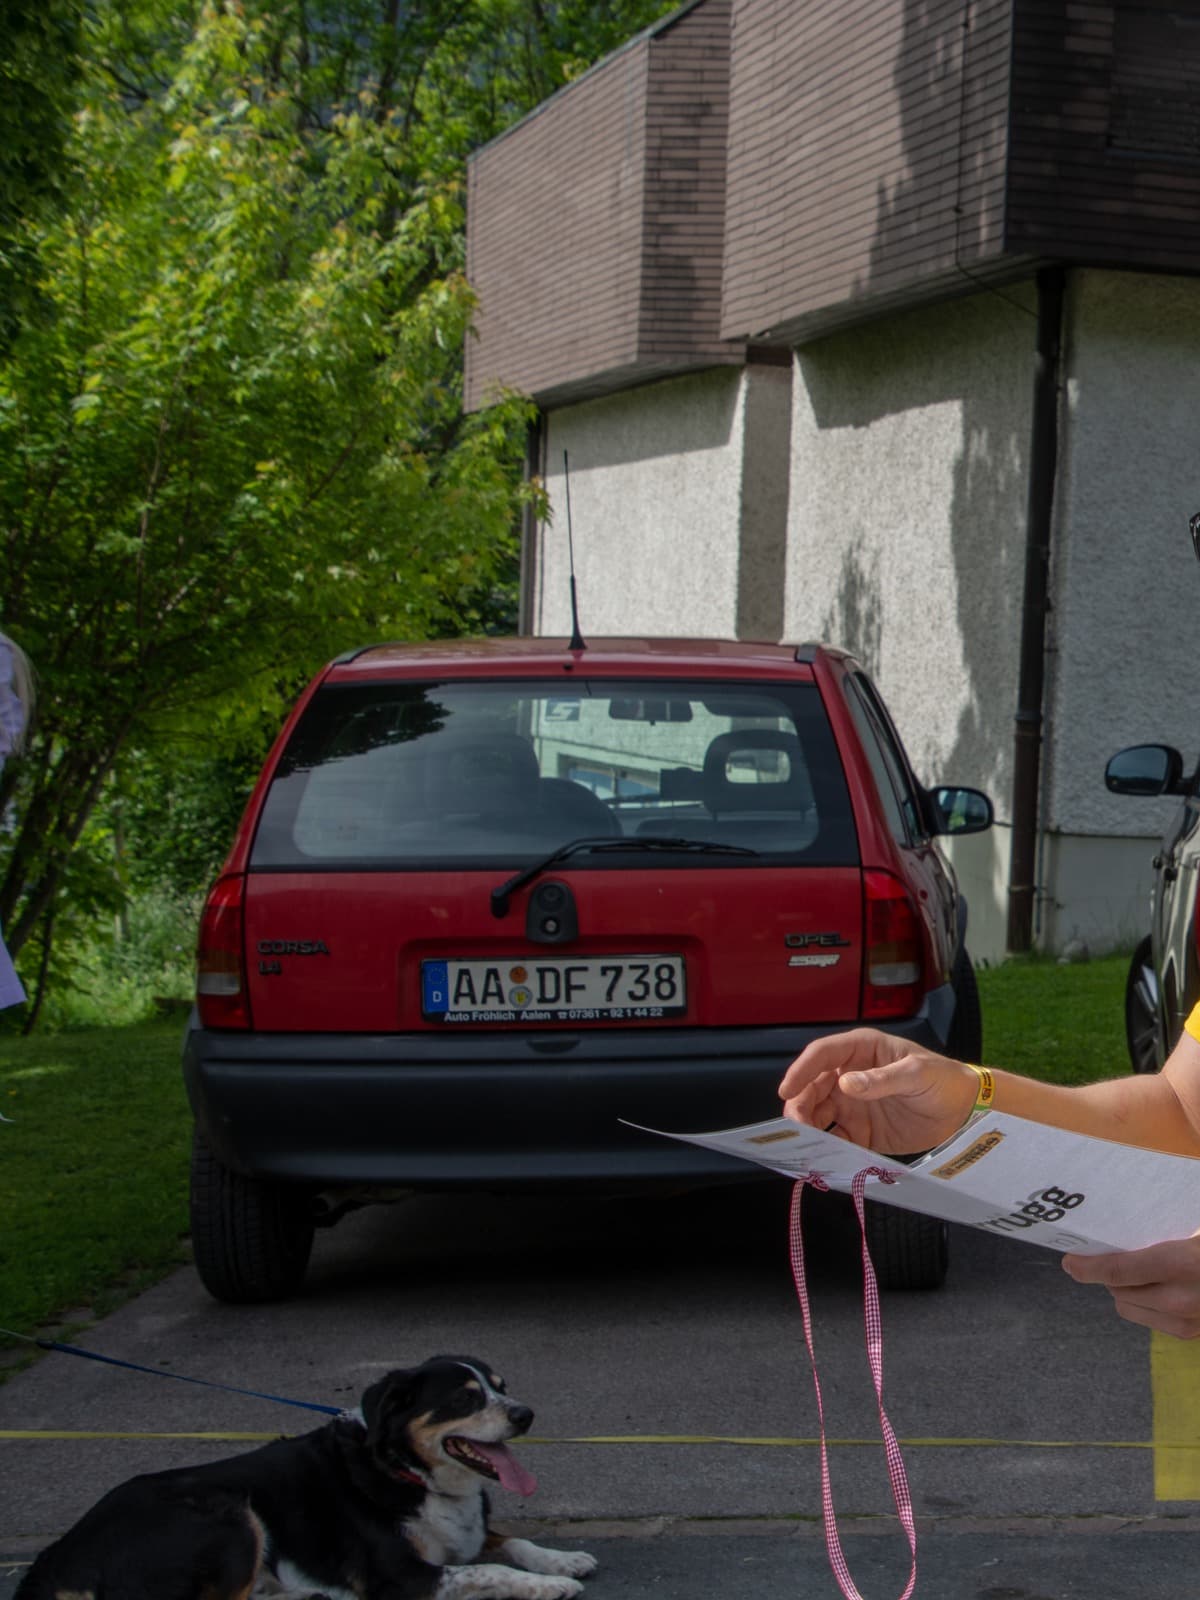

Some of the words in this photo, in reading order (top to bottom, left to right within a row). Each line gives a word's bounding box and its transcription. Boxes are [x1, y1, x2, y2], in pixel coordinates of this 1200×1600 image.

[257, 939, 330, 955] CORSA
[784, 932, 851, 948] OPEL
[452, 967, 505, 1005] AA
[536, 965, 589, 1004] DF
[600, 963, 677, 1001] 738
[432, 990, 442, 1002] D
[444, 1011, 470, 1021] Auto
[472, 1009, 515, 1021] Fröhlich
[521, 1009, 551, 1020] Aalen
[569, 1009, 600, 1019] 07361
[635, 1008, 648, 1017] 44
